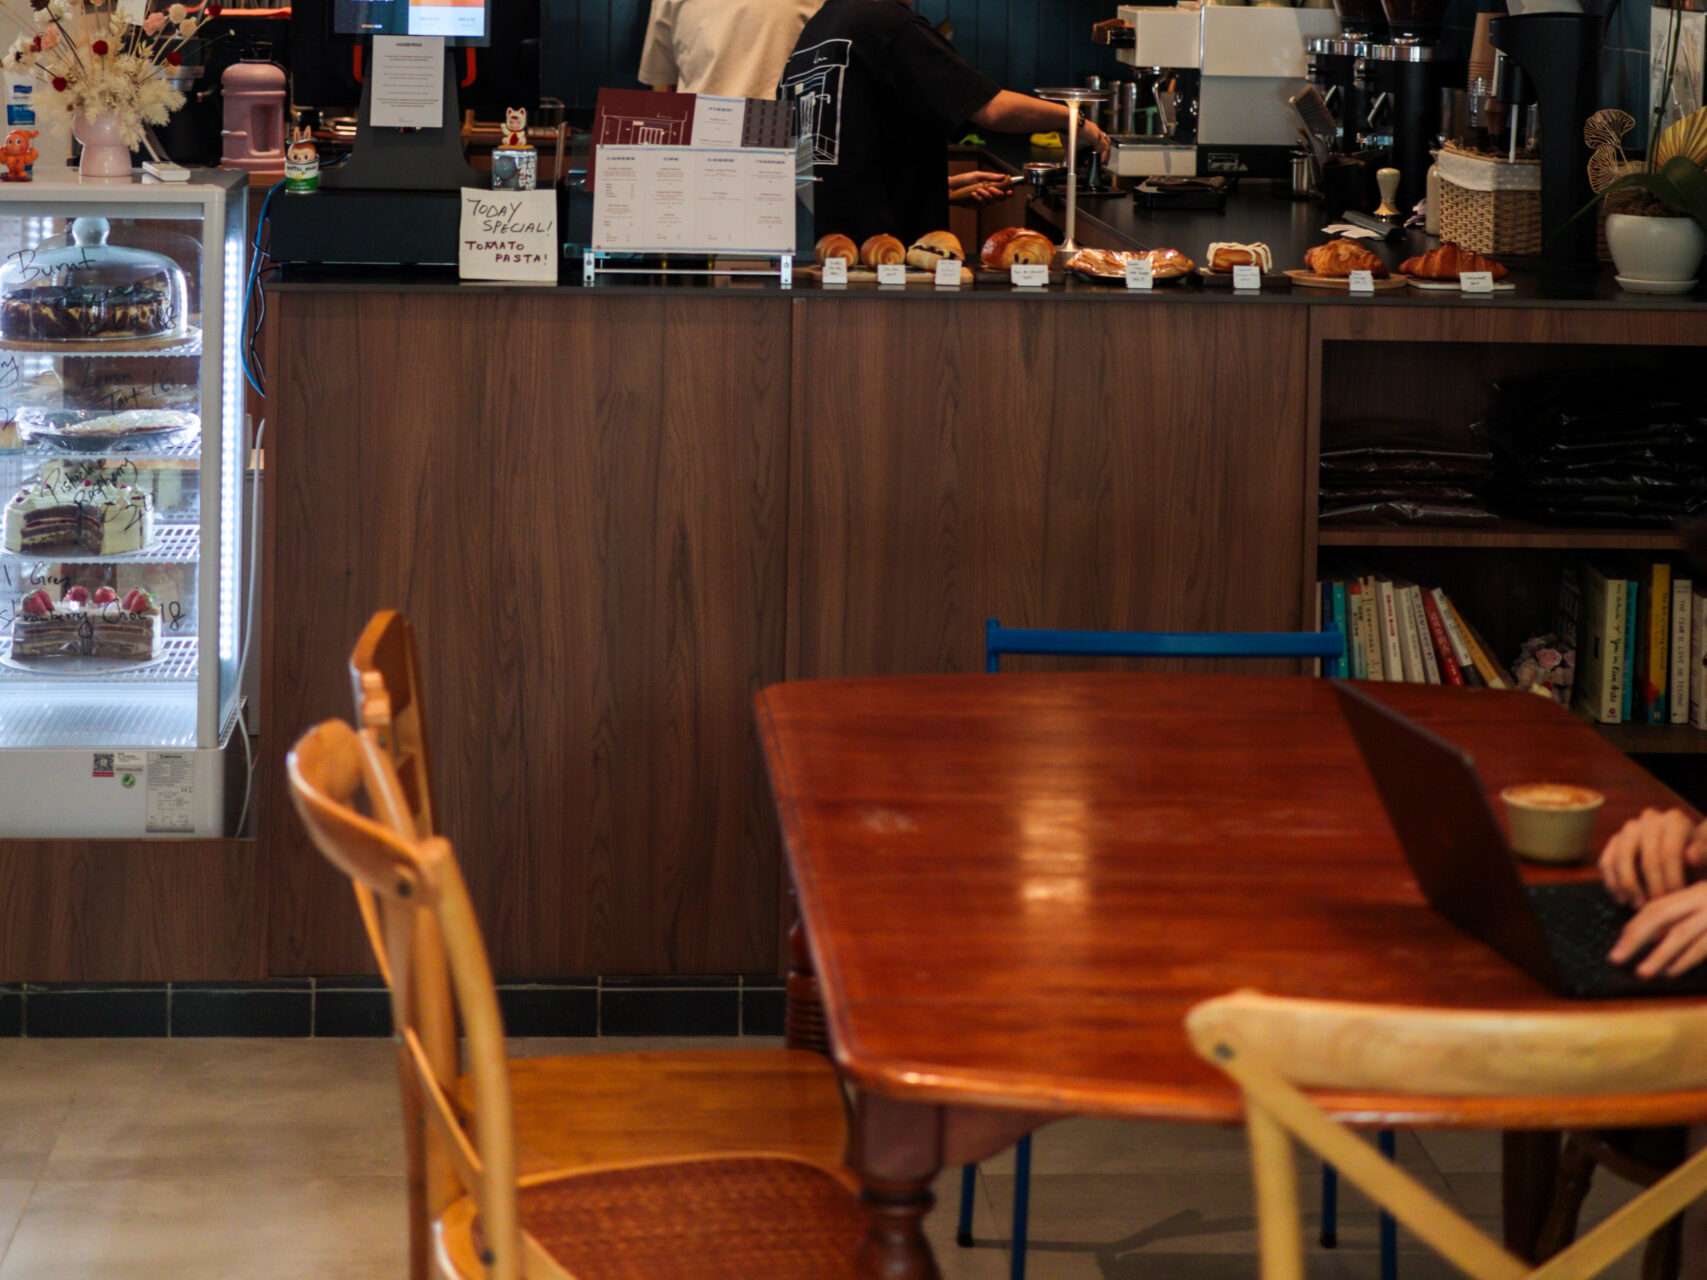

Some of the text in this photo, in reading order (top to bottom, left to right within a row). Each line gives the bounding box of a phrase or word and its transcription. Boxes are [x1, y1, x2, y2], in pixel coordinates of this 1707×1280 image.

[466, 198, 523, 223] TODAY
[482, 219, 553, 237] SPECIAL!
[464, 240, 525, 252] TOMATO
[8, 247, 97, 284] Burnt
[495, 253, 548, 266] PASTA!
[30, 560, 71, 592] Grey
